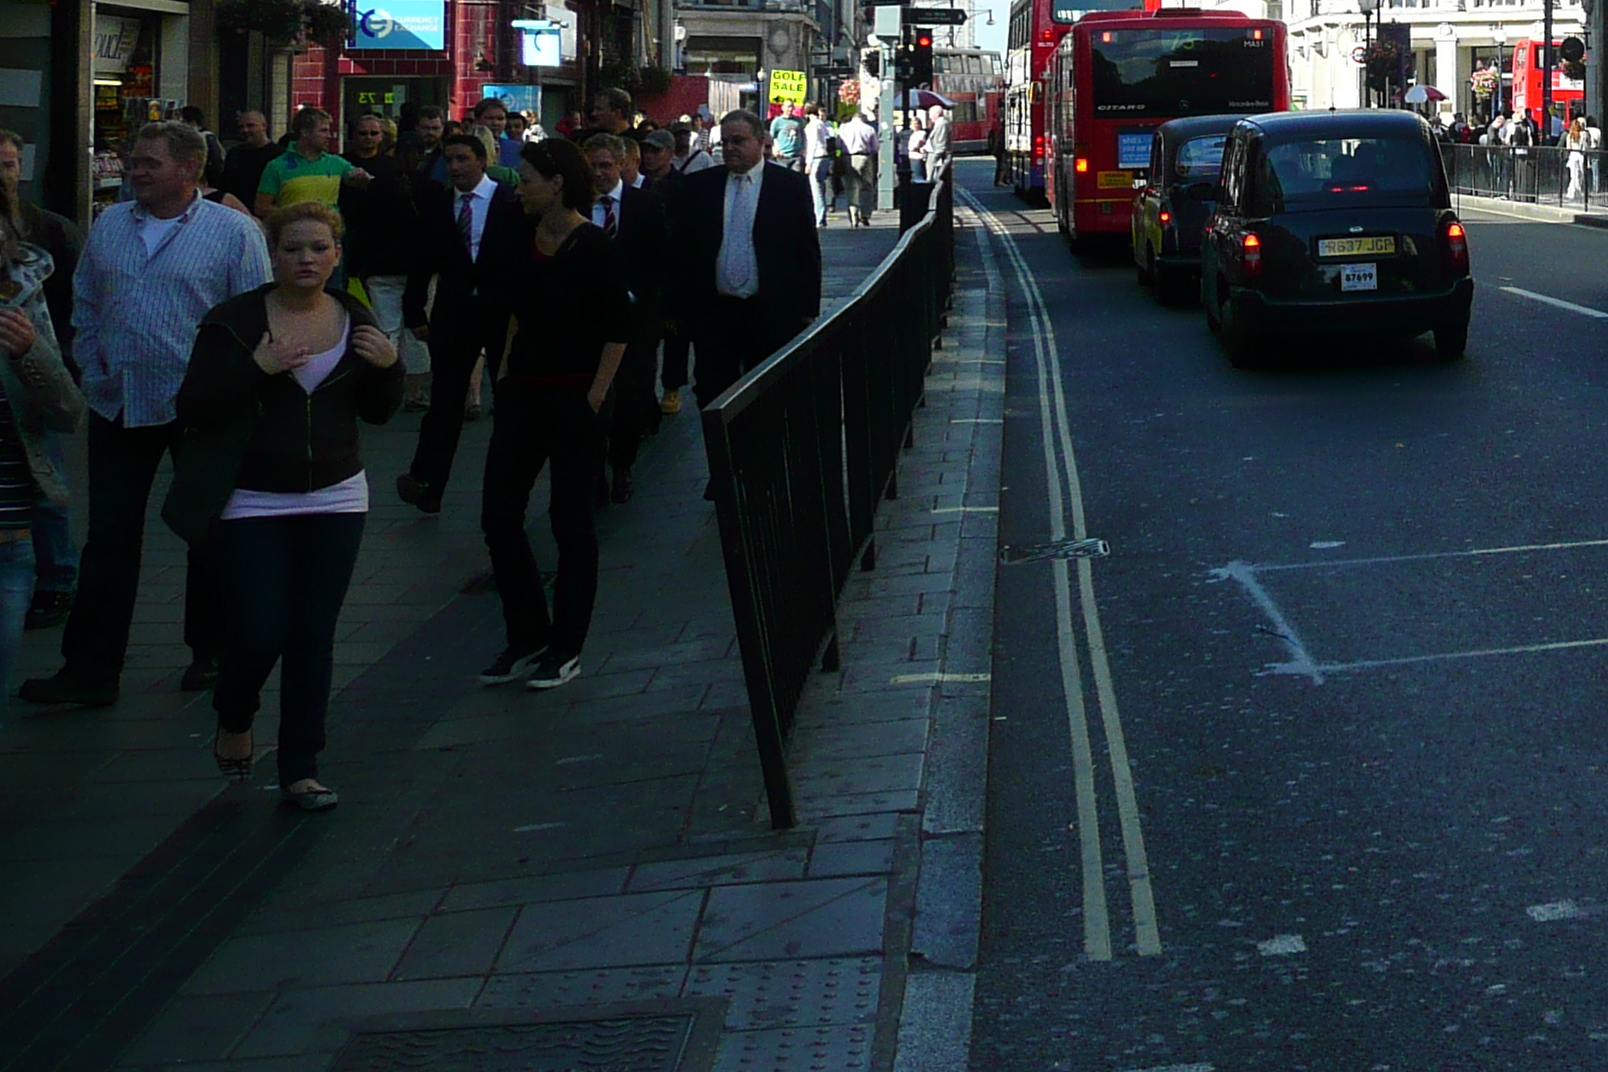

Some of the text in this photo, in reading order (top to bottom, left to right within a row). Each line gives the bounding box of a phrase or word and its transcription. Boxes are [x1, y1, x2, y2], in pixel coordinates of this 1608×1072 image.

[394, 16, 439, 24] CURRENCY
[773, 71, 807, 81] GOLF
[773, 82, 804, 92] SALE
